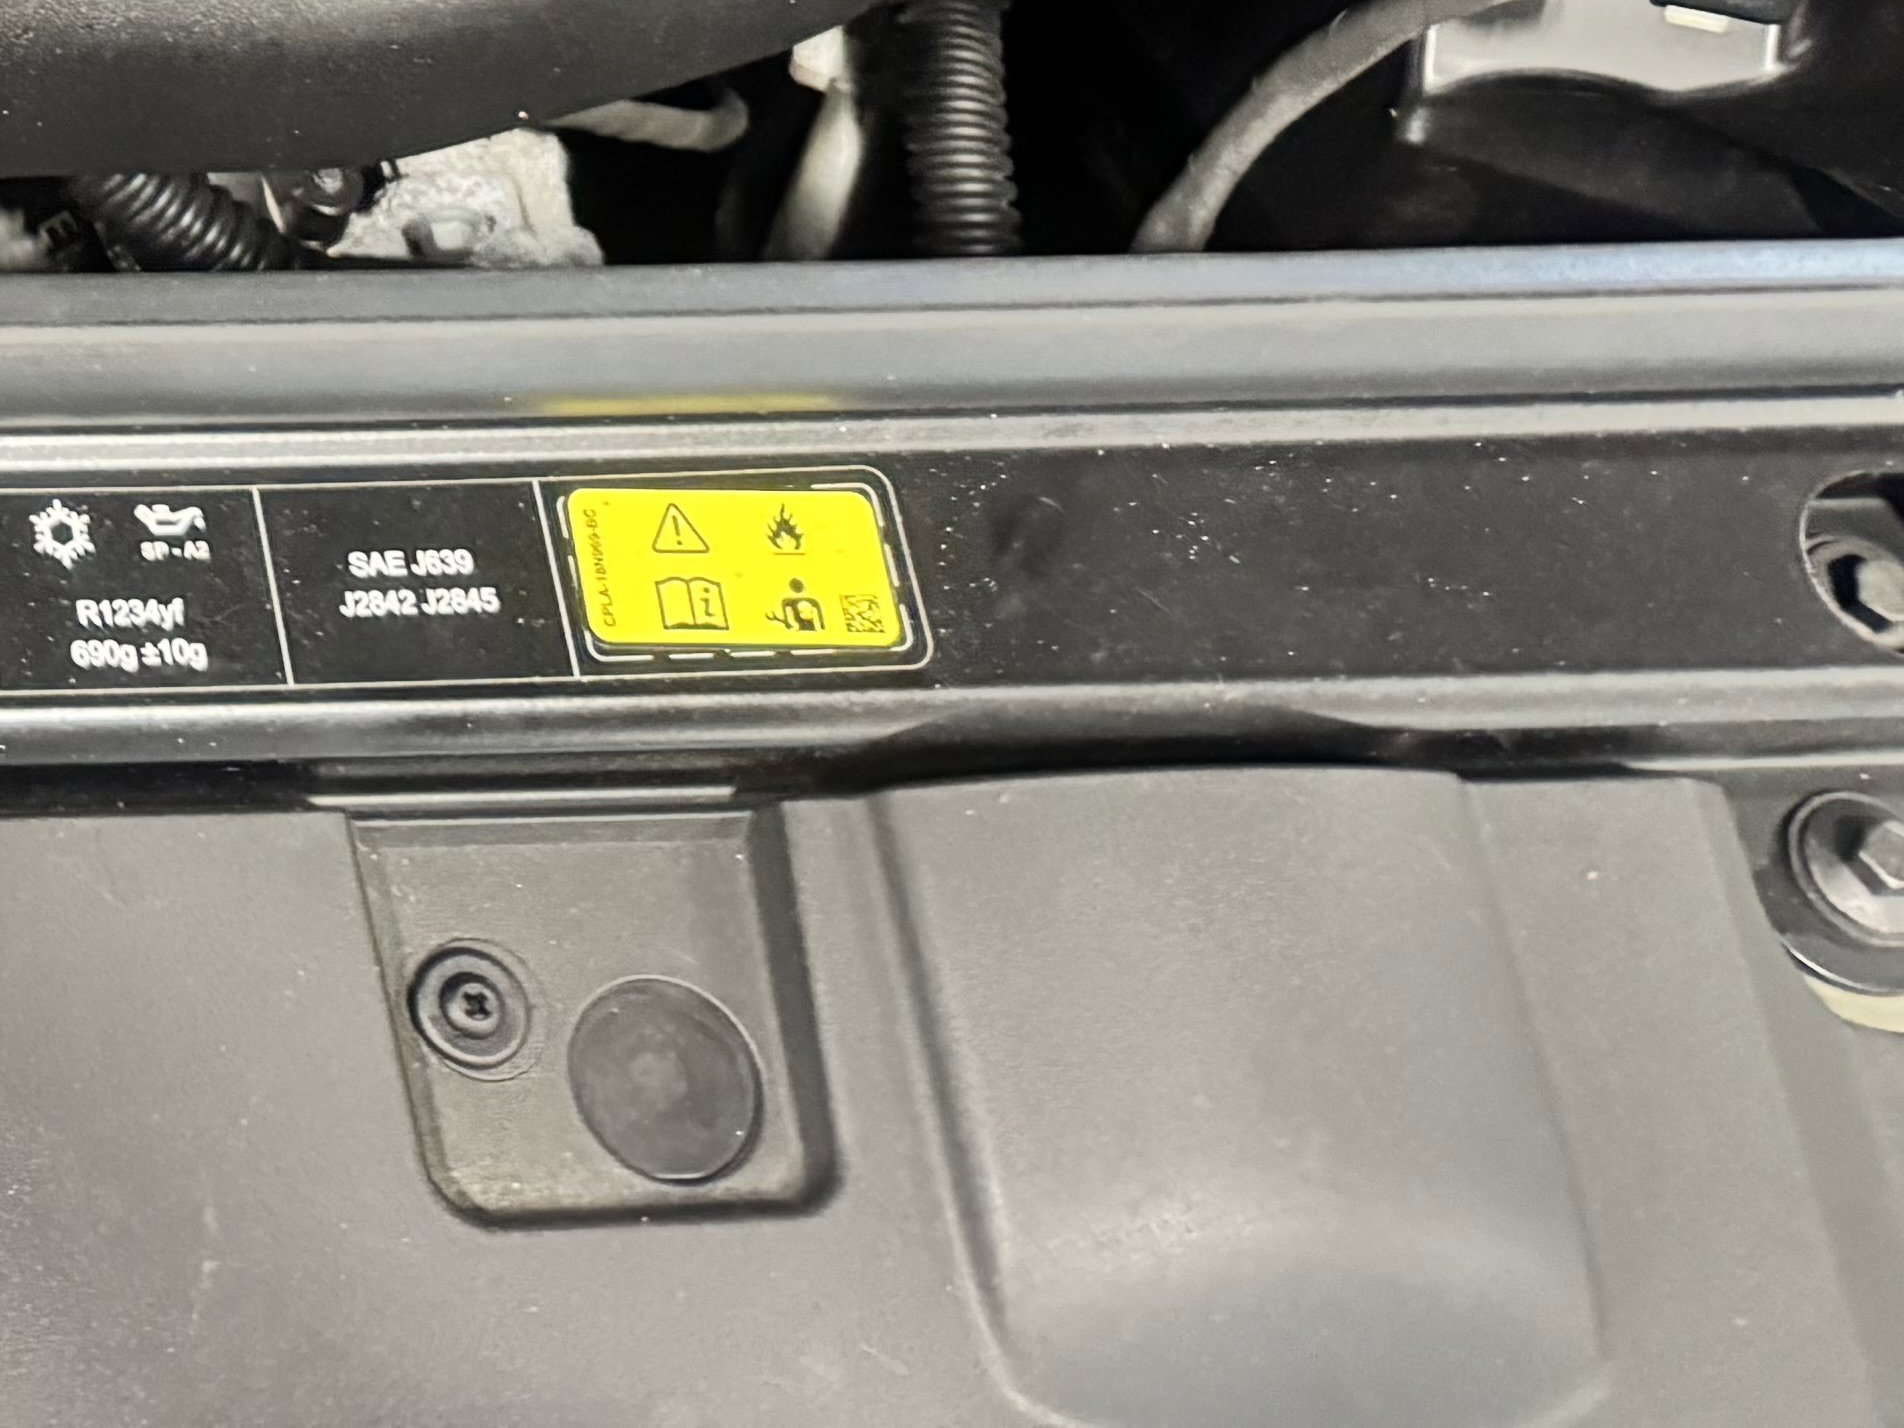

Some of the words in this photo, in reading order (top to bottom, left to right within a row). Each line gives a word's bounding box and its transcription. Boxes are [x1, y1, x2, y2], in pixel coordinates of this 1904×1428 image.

[347, 550, 408, 579] SAE
[410, 548, 475, 577] J639
[75, 597, 186, 632] R1234yf
[338, 588, 419, 618] J2842
[421, 586, 502, 616] J2845
[70, 638, 139, 674] 690g
[140, 637, 209, 672] ±10g
